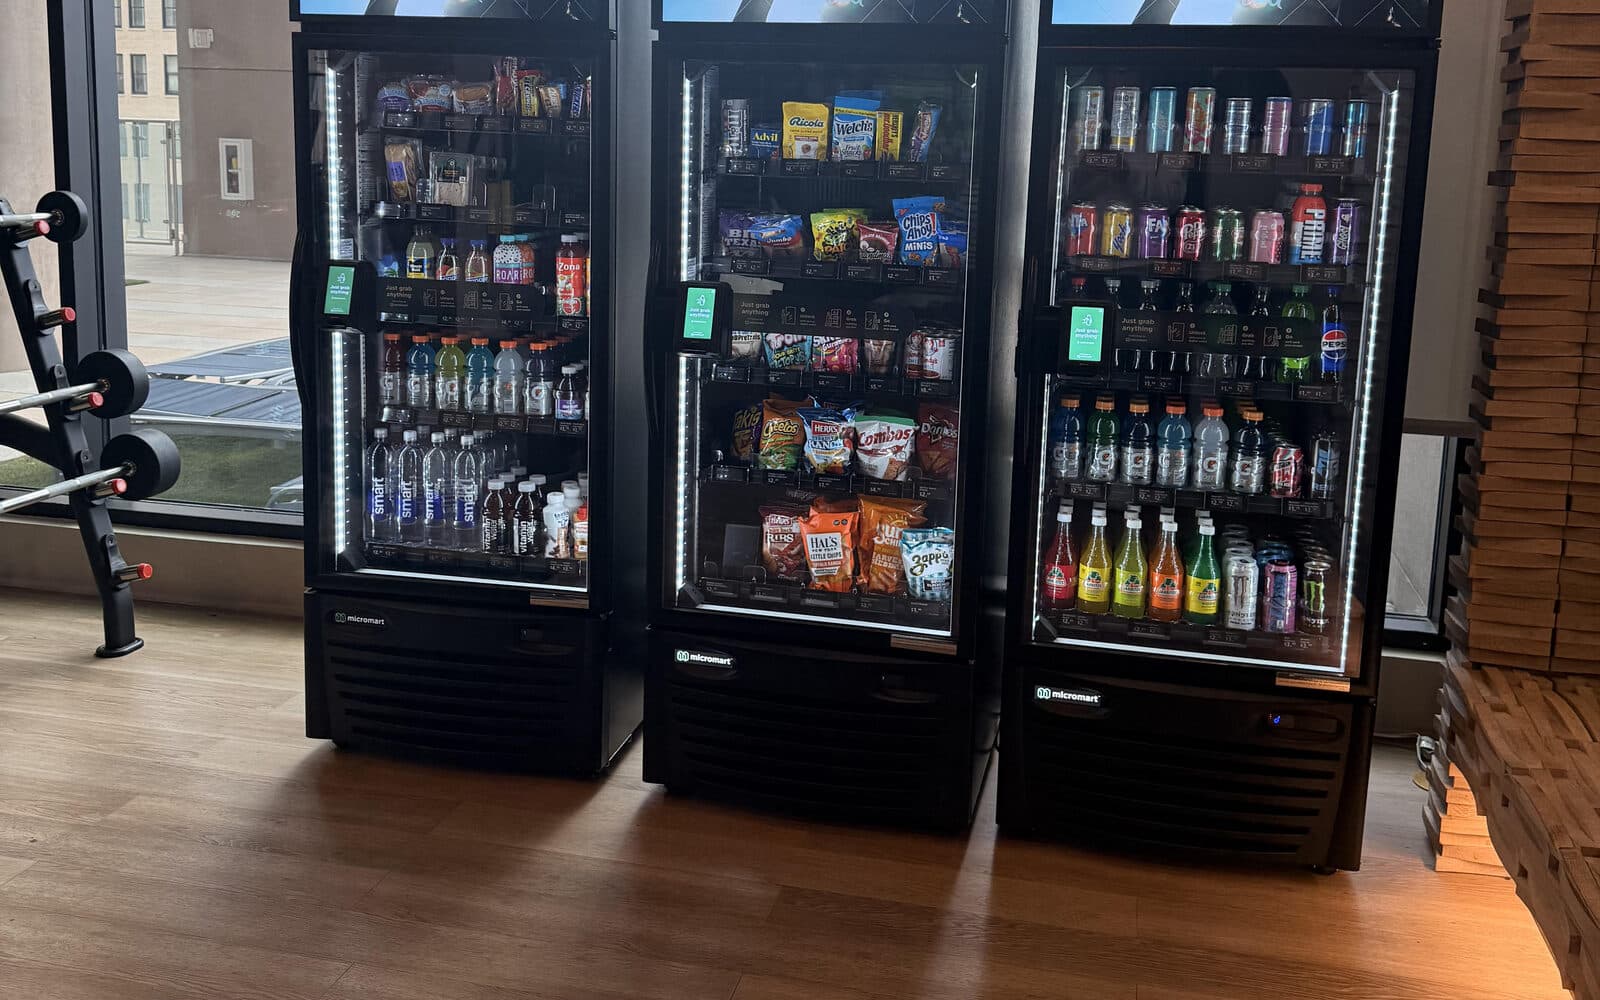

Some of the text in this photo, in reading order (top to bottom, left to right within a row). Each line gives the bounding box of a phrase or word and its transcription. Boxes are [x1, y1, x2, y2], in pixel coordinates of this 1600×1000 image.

[789, 117, 824, 127] Ricola
[836, 120, 873, 135] Welch's
[753, 132, 778, 142] Advil
[903, 213, 931, 230] Chips
[1301, 208, 1326, 260] PRIME
[725, 238, 763, 247] TEXA
[558, 262, 580, 271] Zona
[495, 269, 520, 281] ROAR
[386, 291, 412, 300] anything
[399, 286, 412, 294] grab
[741, 309, 769, 317] anything
[1121, 325, 1153, 333] anything
[814, 424, 838, 433] HERR'S
[858, 426, 912, 447] Combos
[374, 477, 385, 516] smart
[402, 481, 413, 519] smart
[425, 481, 434, 519] smart
[465, 484, 476, 522] smart
[519, 520, 527, 553] vitamin
[767, 533, 794, 543] RIBS
[810, 537, 838, 549] HAL'S
[347, 614, 385, 626] micromart
[690, 653, 732, 665] micromart
[1052, 689, 1099, 702] micromart
